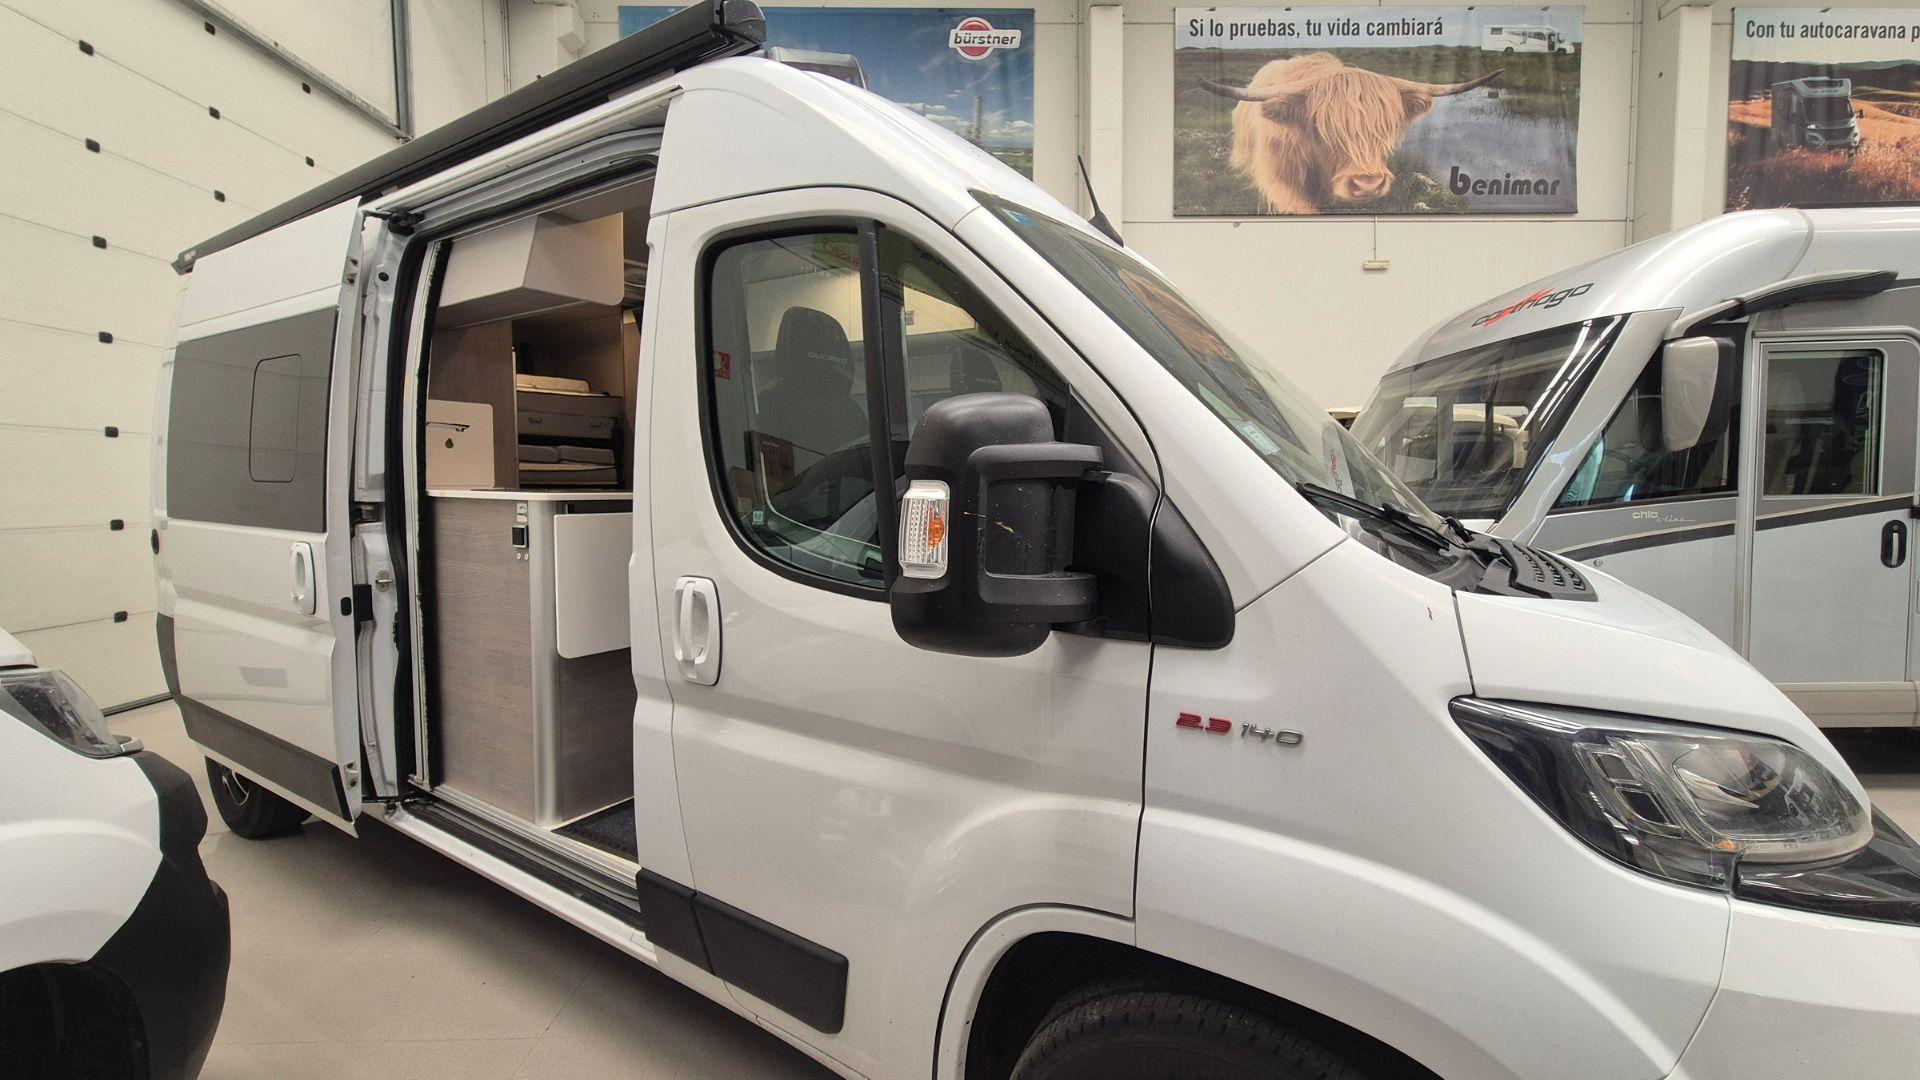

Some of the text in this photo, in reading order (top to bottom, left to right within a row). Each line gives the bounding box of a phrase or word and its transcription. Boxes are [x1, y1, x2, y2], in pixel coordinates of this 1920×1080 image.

[954, 32, 1017, 45] bürstner
[1189, 16, 1444, 40] Si lo pruebas, tu vida cambiará
[1746, 20, 1775, 38] Con
[1780, 21, 1795, 38] tu
[1800, 21, 1906, 39] autocaravana
[1449, 165, 1560, 195] benimar
[1632, 510, 1658, 519] chic
[1176, 711, 1303, 745] 2.3 140
